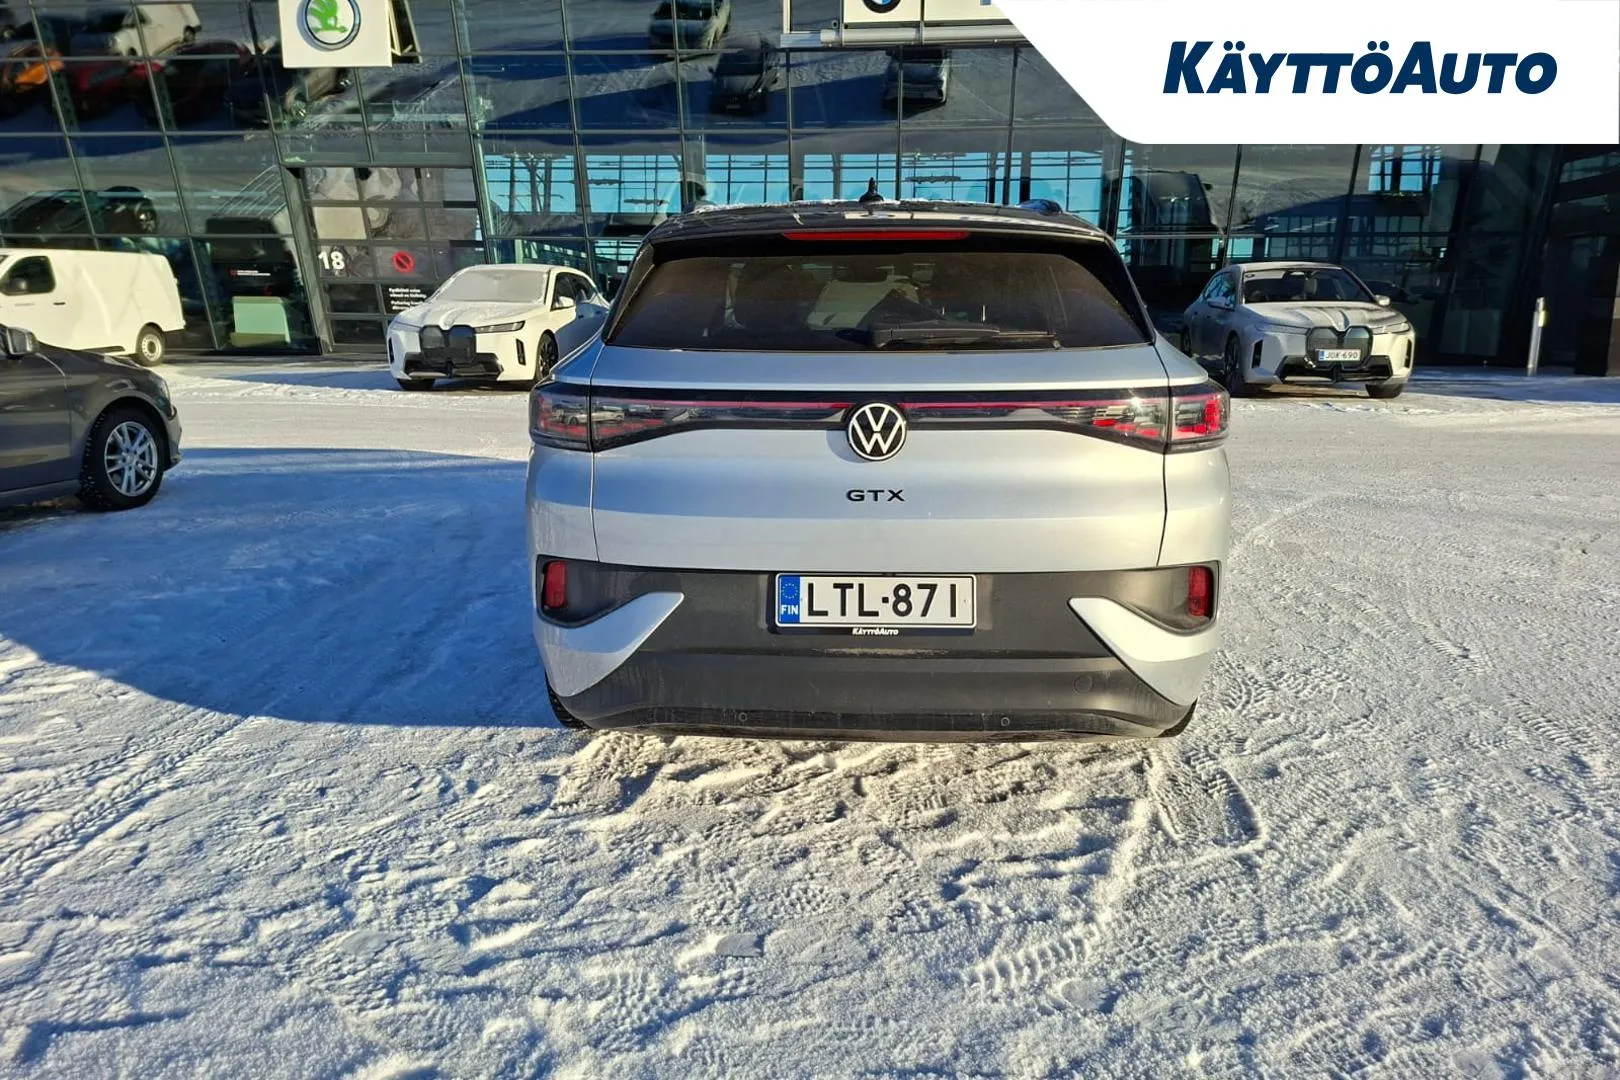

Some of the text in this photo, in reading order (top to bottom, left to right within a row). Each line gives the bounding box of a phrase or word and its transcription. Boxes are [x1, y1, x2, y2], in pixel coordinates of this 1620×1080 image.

[318, 249, 345, 271] 18
[846, 489, 905, 502] GTX
[807, 583, 957, 618] LTL-871
[781, 604, 799, 616] FIN
